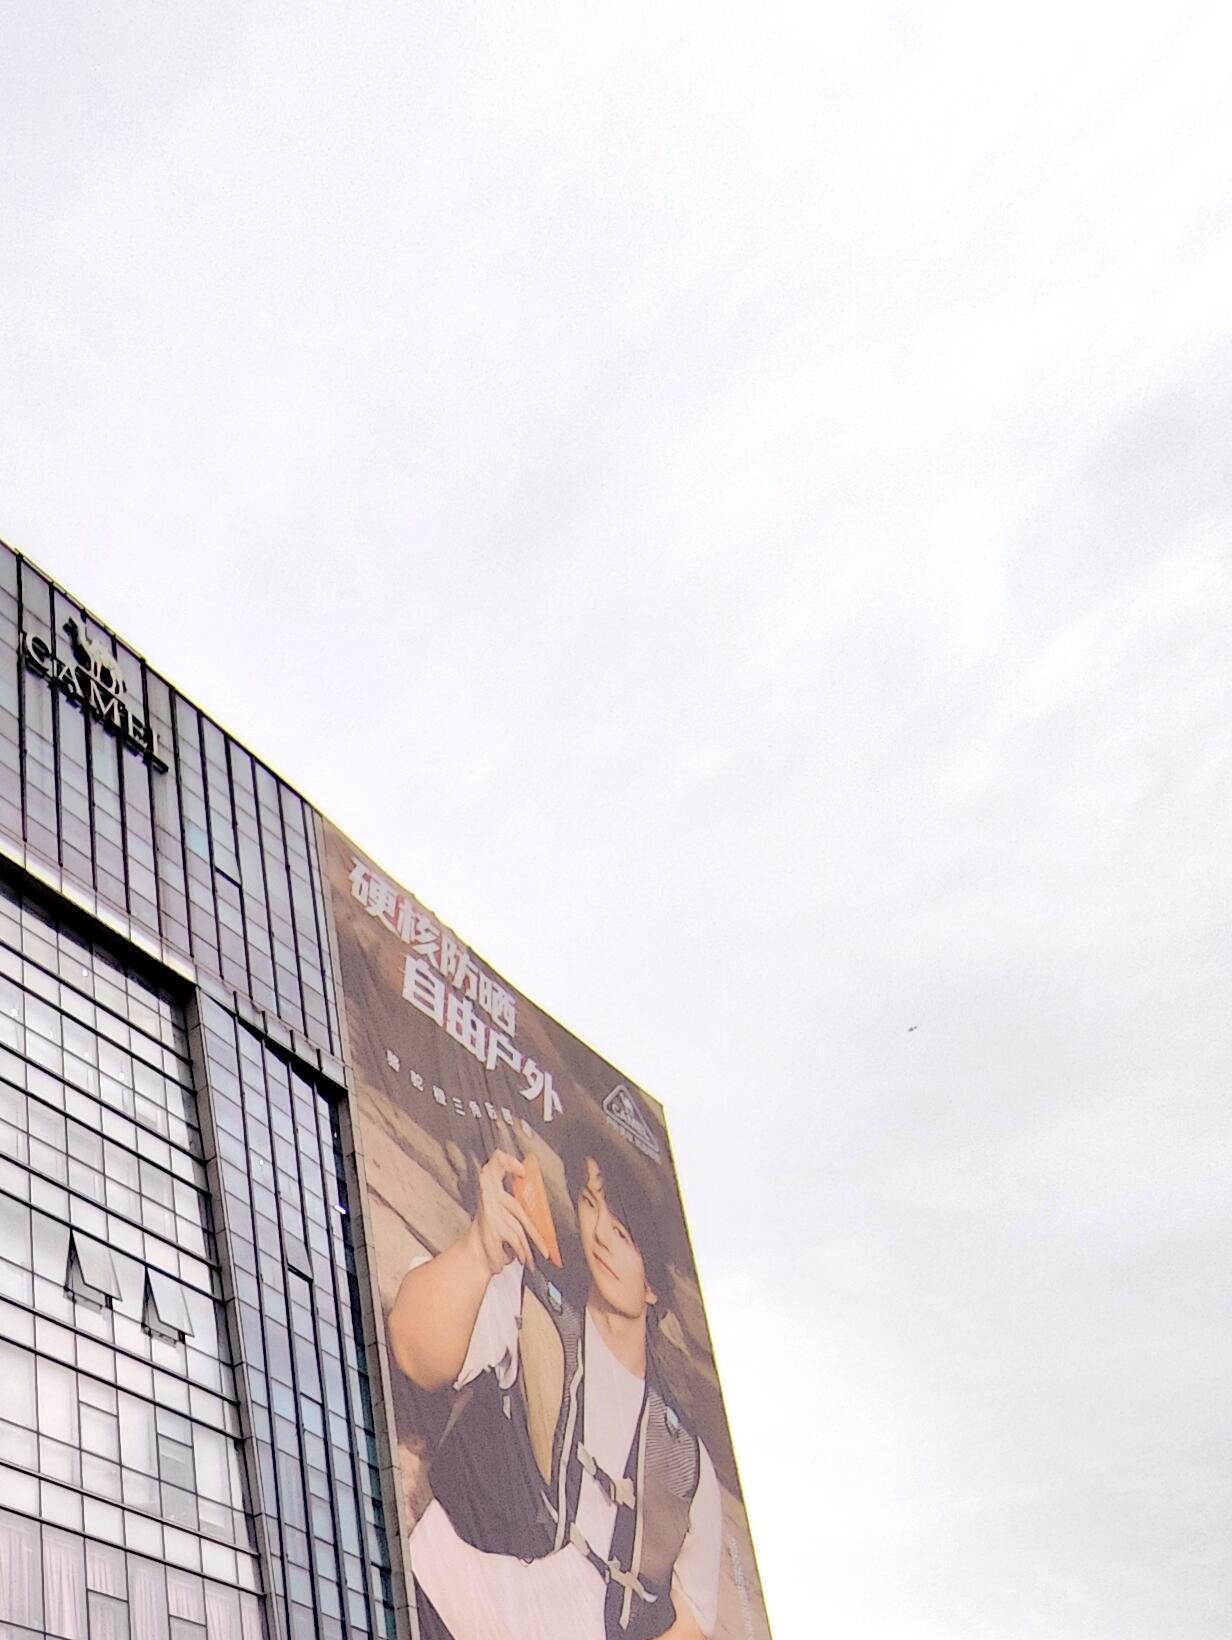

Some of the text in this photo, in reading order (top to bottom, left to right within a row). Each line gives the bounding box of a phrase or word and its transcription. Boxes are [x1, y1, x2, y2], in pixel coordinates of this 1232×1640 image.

[23, 631, 162, 758] CAMEL
[349, 855, 517, 1038] 硬核防晒
[401, 952, 564, 1123] 自由户外
